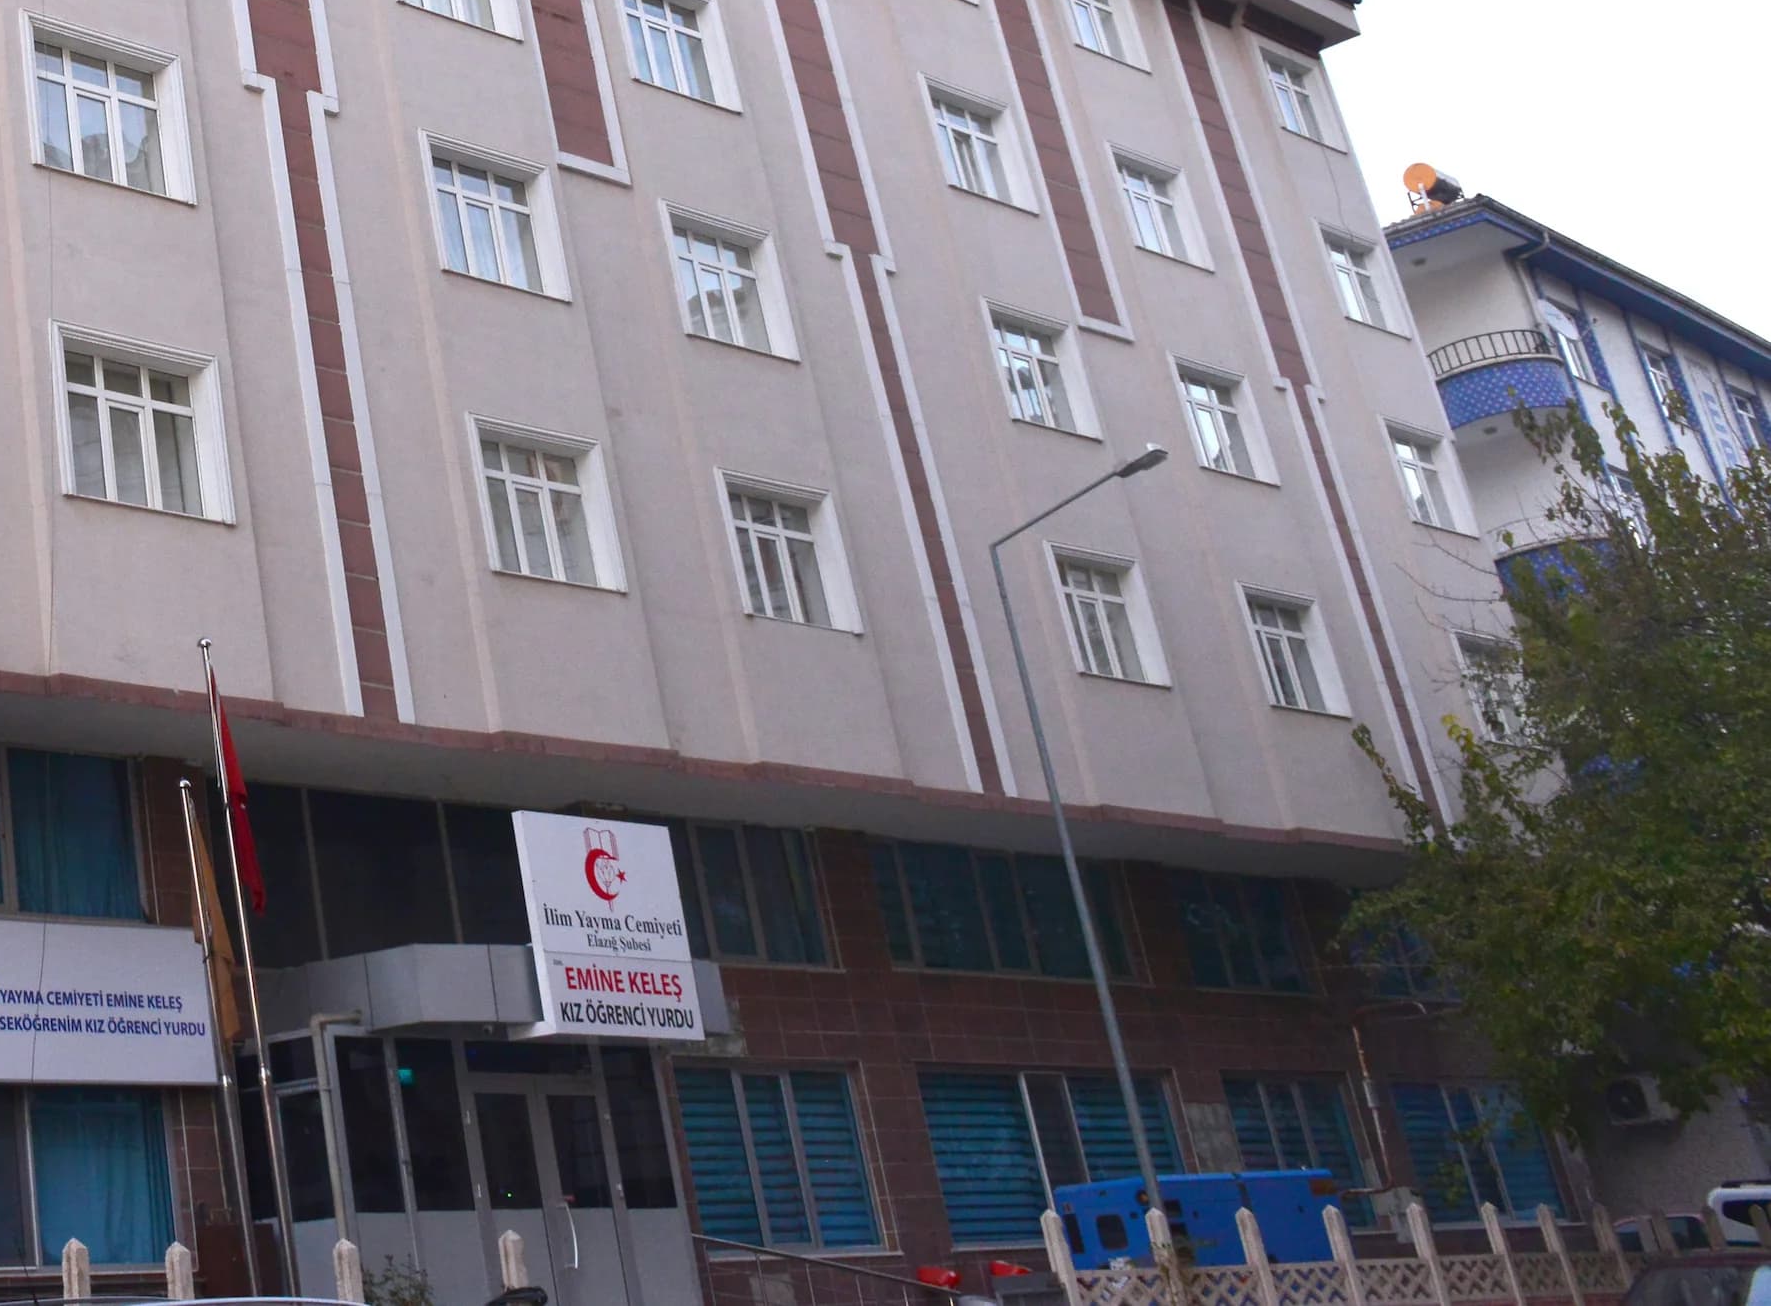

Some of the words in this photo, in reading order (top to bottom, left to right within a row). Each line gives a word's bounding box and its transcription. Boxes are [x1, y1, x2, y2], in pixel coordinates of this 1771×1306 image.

[543, 903, 573, 927] İlim
[575, 910, 622, 934] Yayma
[624, 915, 683, 939] Cemiyeti
[587, 933, 618, 951] Elazığ
[619, 936, 651, 952] Şubesi
[565, 963, 625, 993] EMİNE
[628, 971, 683, 1002] KELEŞ
[0, 989, 44, 1005] YAYMA
[46, 989, 104, 1007] CEMİYETİ
[107, 991, 145, 1009] EMİNE
[147, 995, 183, 1013] KELEŞ
[560, 1001, 584, 1023] KIZ
[586, 999, 646, 1026] ÖĞRENCİ
[647, 1006, 694, 1029] YURDU
[85, 1019, 105, 1034] KIZ
[108, 1017, 162, 1035] ÖĞRENCİ
[164, 1021, 205, 1037] YURDU
